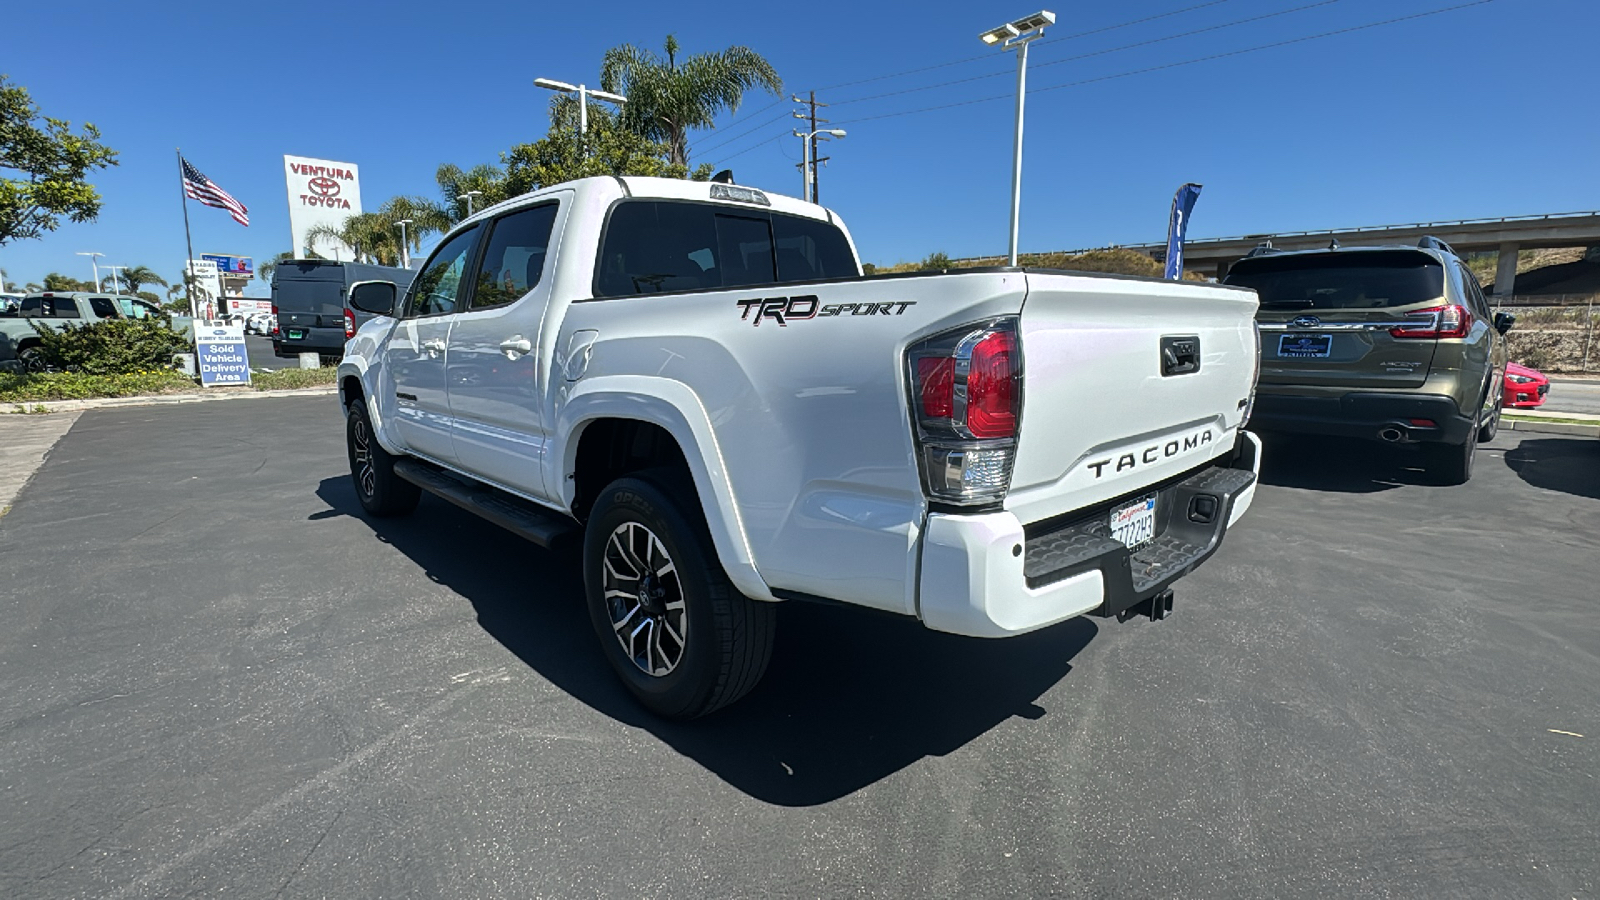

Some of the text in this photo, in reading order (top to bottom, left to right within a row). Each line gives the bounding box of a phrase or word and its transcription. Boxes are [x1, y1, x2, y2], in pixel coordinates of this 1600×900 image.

[290, 163, 354, 181] VENTURA
[300, 194, 351, 210] TOYOTA
[737, 295, 917, 327] TRD SPORT
[209, 344, 235, 353] Sold
[203, 354, 243, 363] Vehicle
[202, 363, 246, 373] Delivery
[215, 372, 241, 382] Area
[1087, 429, 1213, 478] TACOMA
